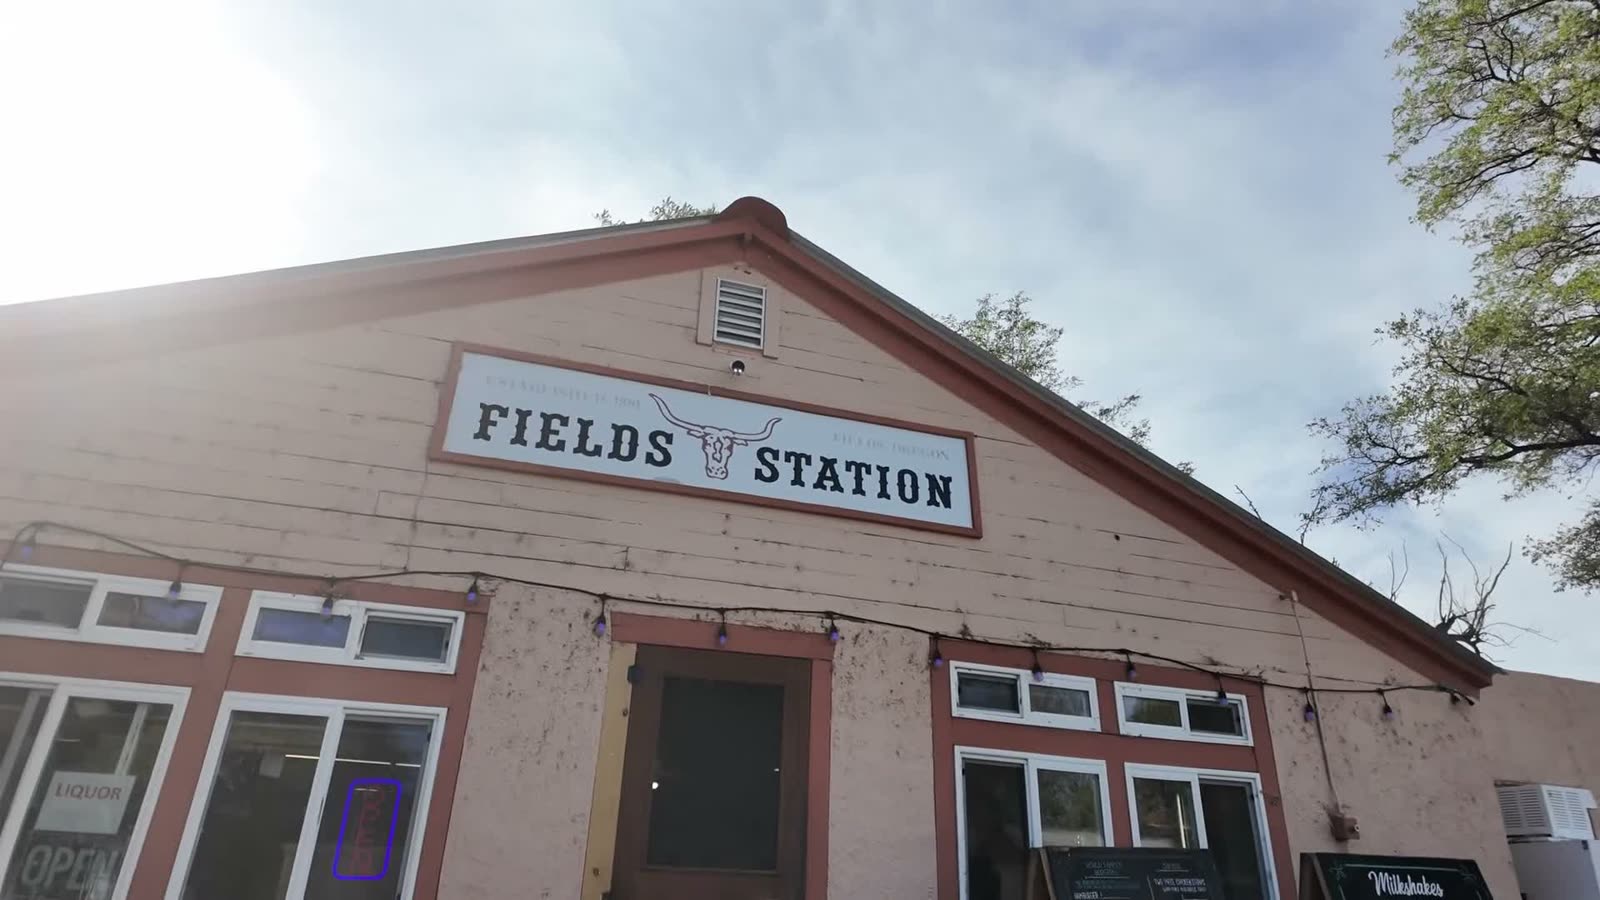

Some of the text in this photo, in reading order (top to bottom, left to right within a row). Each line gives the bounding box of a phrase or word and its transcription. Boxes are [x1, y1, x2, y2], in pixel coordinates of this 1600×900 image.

[473, 402, 674, 467] FIELDS
[754, 447, 953, 509] STATION
[55, 783, 122, 800] LIQUOR
[21, 844, 119, 892] OPEN
[1368, 871, 1443, 897] Milkshakes
